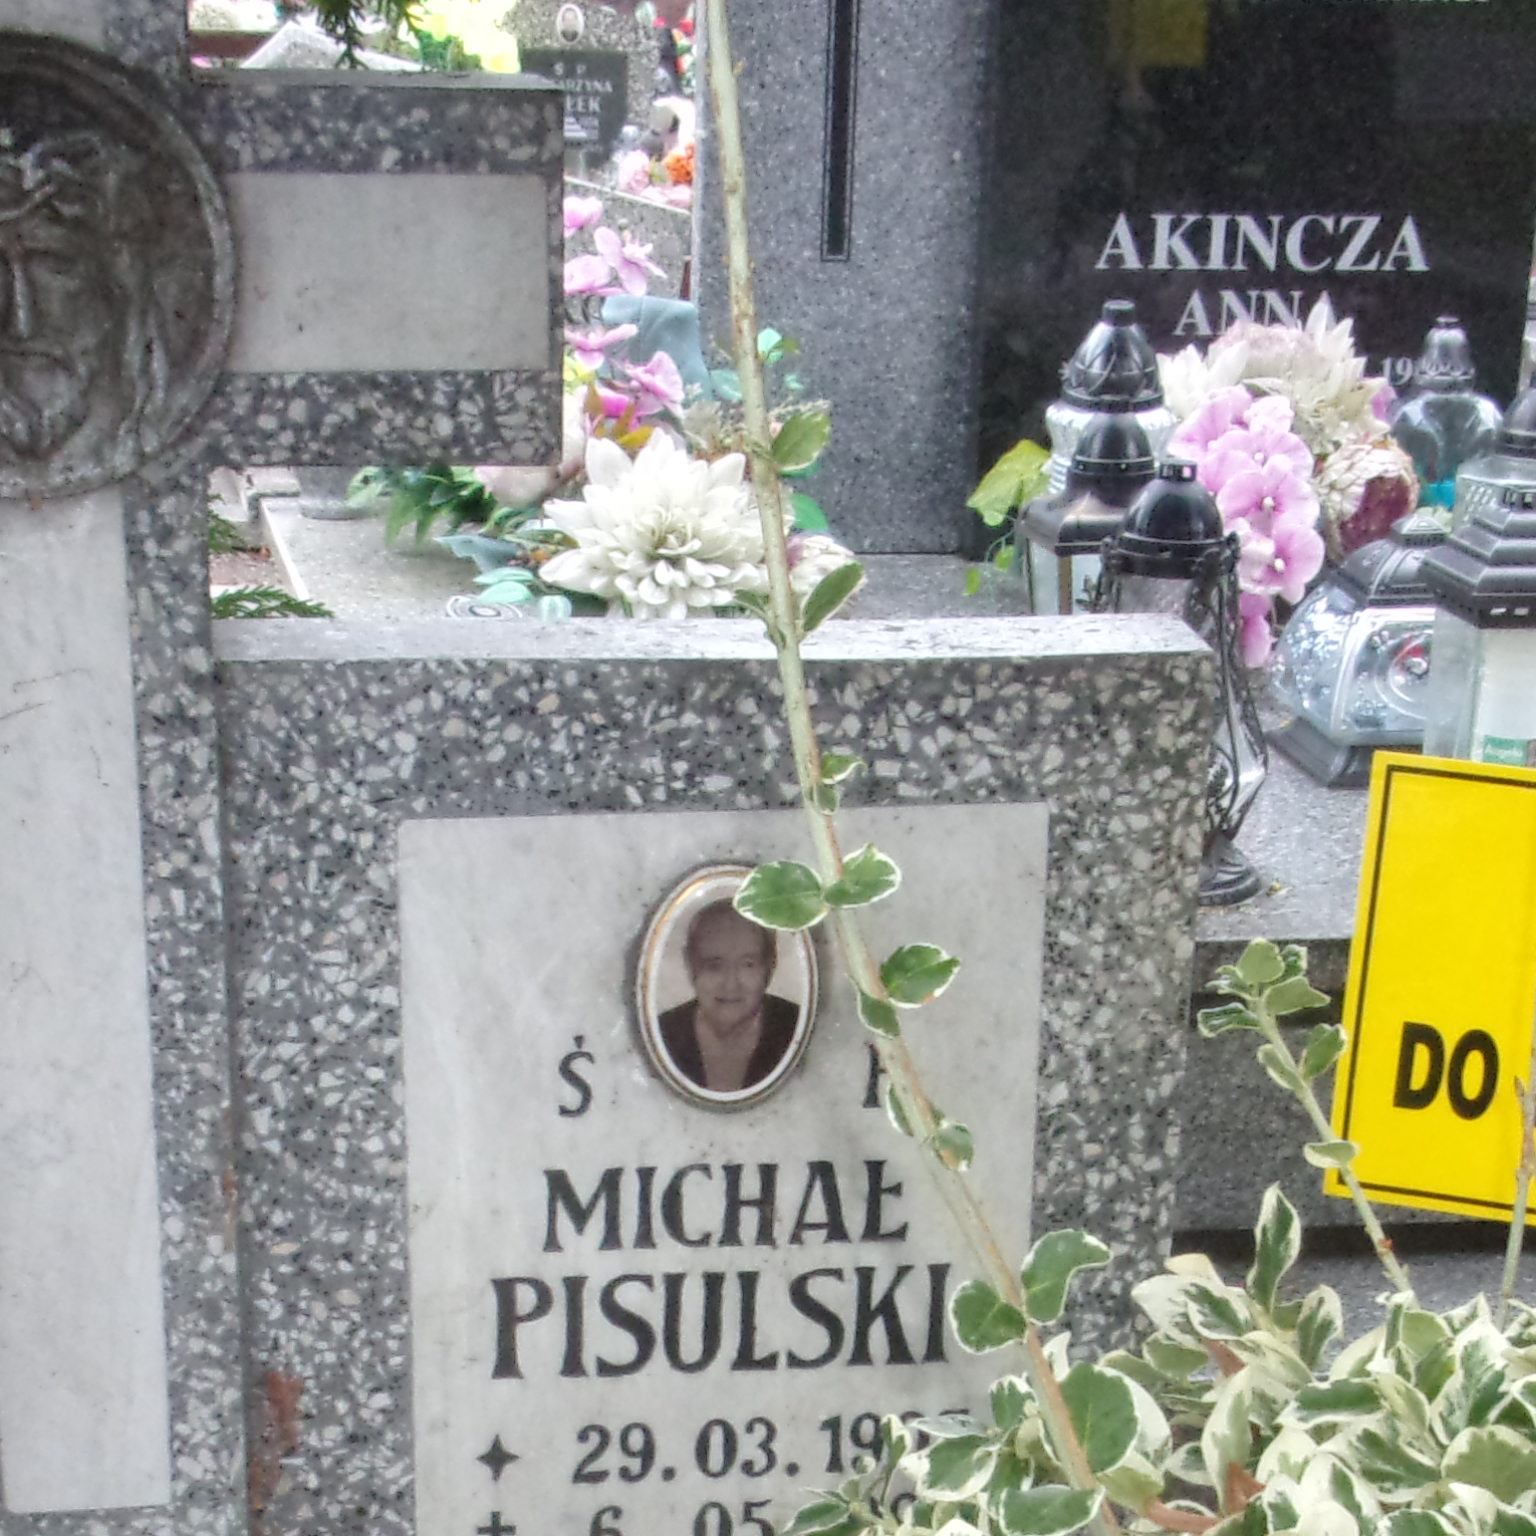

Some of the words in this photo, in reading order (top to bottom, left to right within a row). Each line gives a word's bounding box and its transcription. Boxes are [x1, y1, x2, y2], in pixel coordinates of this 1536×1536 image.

[1095, 212, 1431, 273] AKINCZA
[1173, 289, 1305, 337] ANN
[557, 1035, 596, 1117] Ś
[1393, 1020, 1500, 1121] DO
[542, 1159, 908, 1254] MICHAŁ
[490, 1263, 951, 1380] PISULSKI
